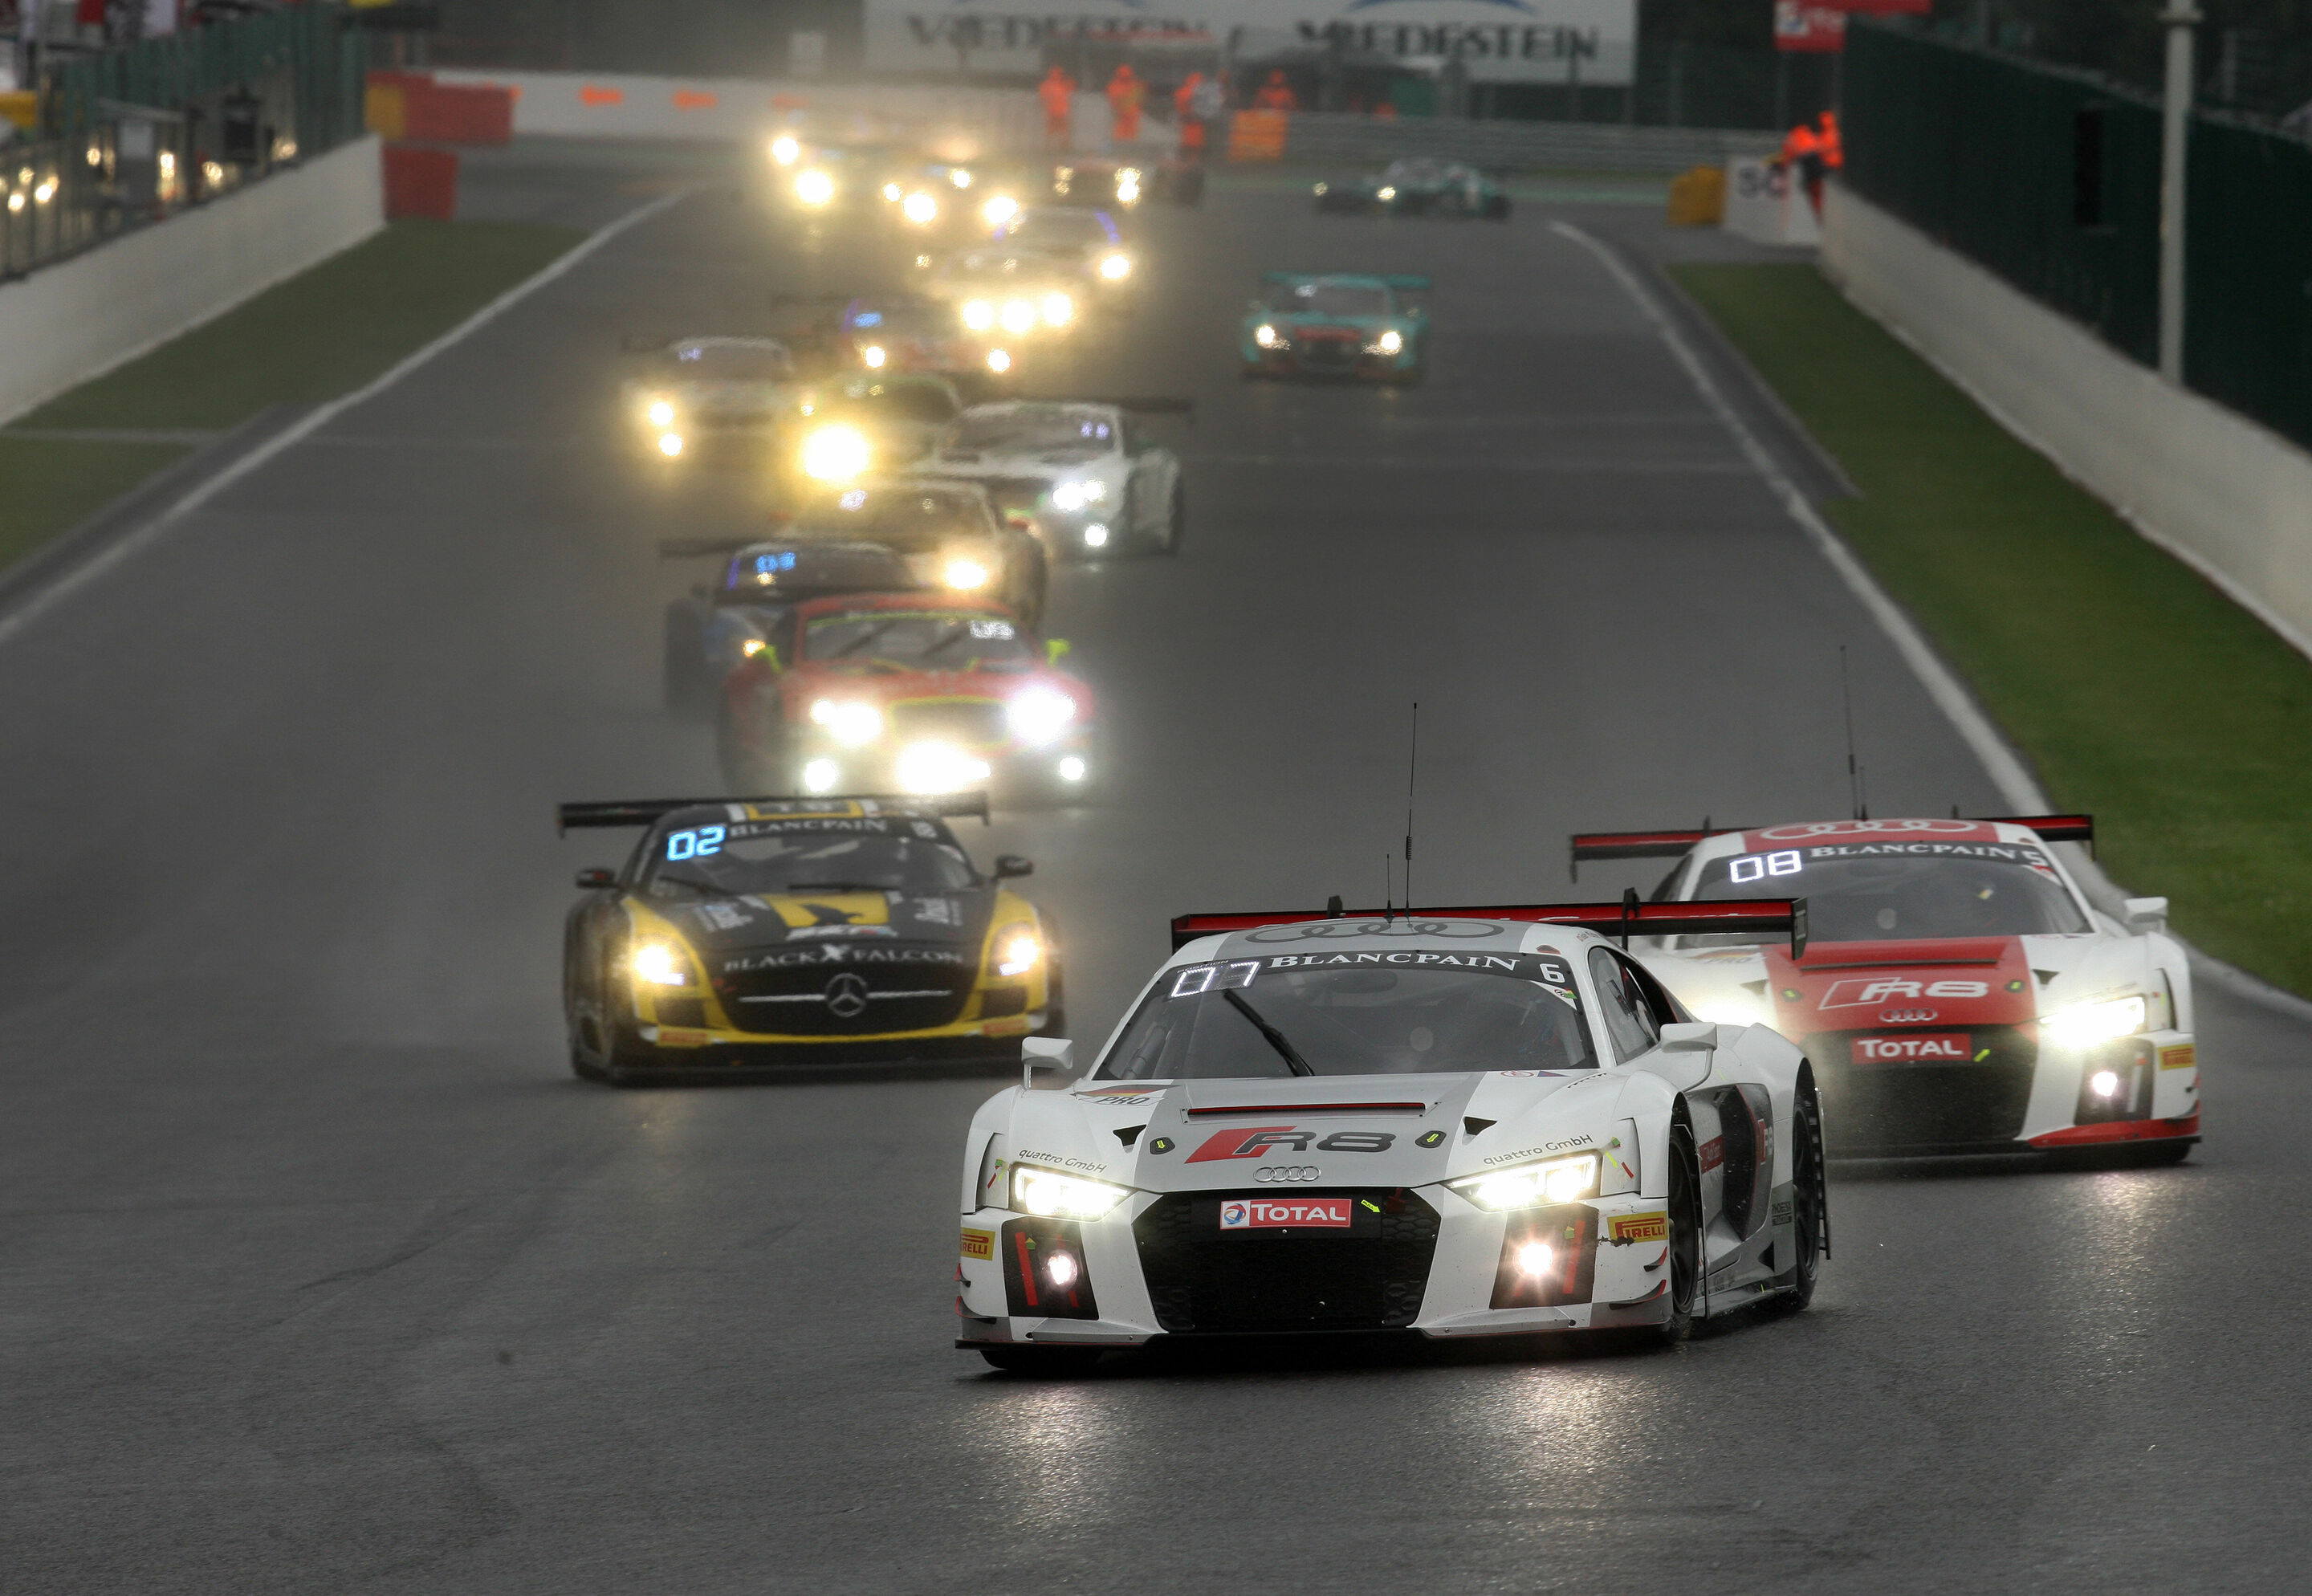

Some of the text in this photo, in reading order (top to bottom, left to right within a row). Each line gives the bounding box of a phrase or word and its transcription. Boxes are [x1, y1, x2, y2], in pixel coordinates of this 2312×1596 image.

[730, 819, 887, 837] BLANCPAIN
[667, 826, 726, 861] 02
[1810, 844, 2017, 859] BLANCPAIN
[1729, 850, 1803, 884] 08
[2021, 850, 2049, 867] 5
[724, 951, 817, 971] BLACK
[853, 949, 963, 963] FALCON
[1267, 953, 1520, 971] BLANCPAIN
[1170, 962, 1260, 997] 07
[1539, 963, 1566, 983] 6
[1858, 979, 1990, 1002] R8
[1857, 1039, 1964, 1058] TOTAL
[1095, 1096, 1150, 1105] PRO
[1231, 1130, 1397, 1155] R8
[1483, 1134, 1594, 1166] quattro GmbH
[1019, 1149, 1108, 1173] quattro GmbH
[1251, 1203, 1346, 1221] TOTAL
[1615, 1217, 1666, 1238] PIRELLI
